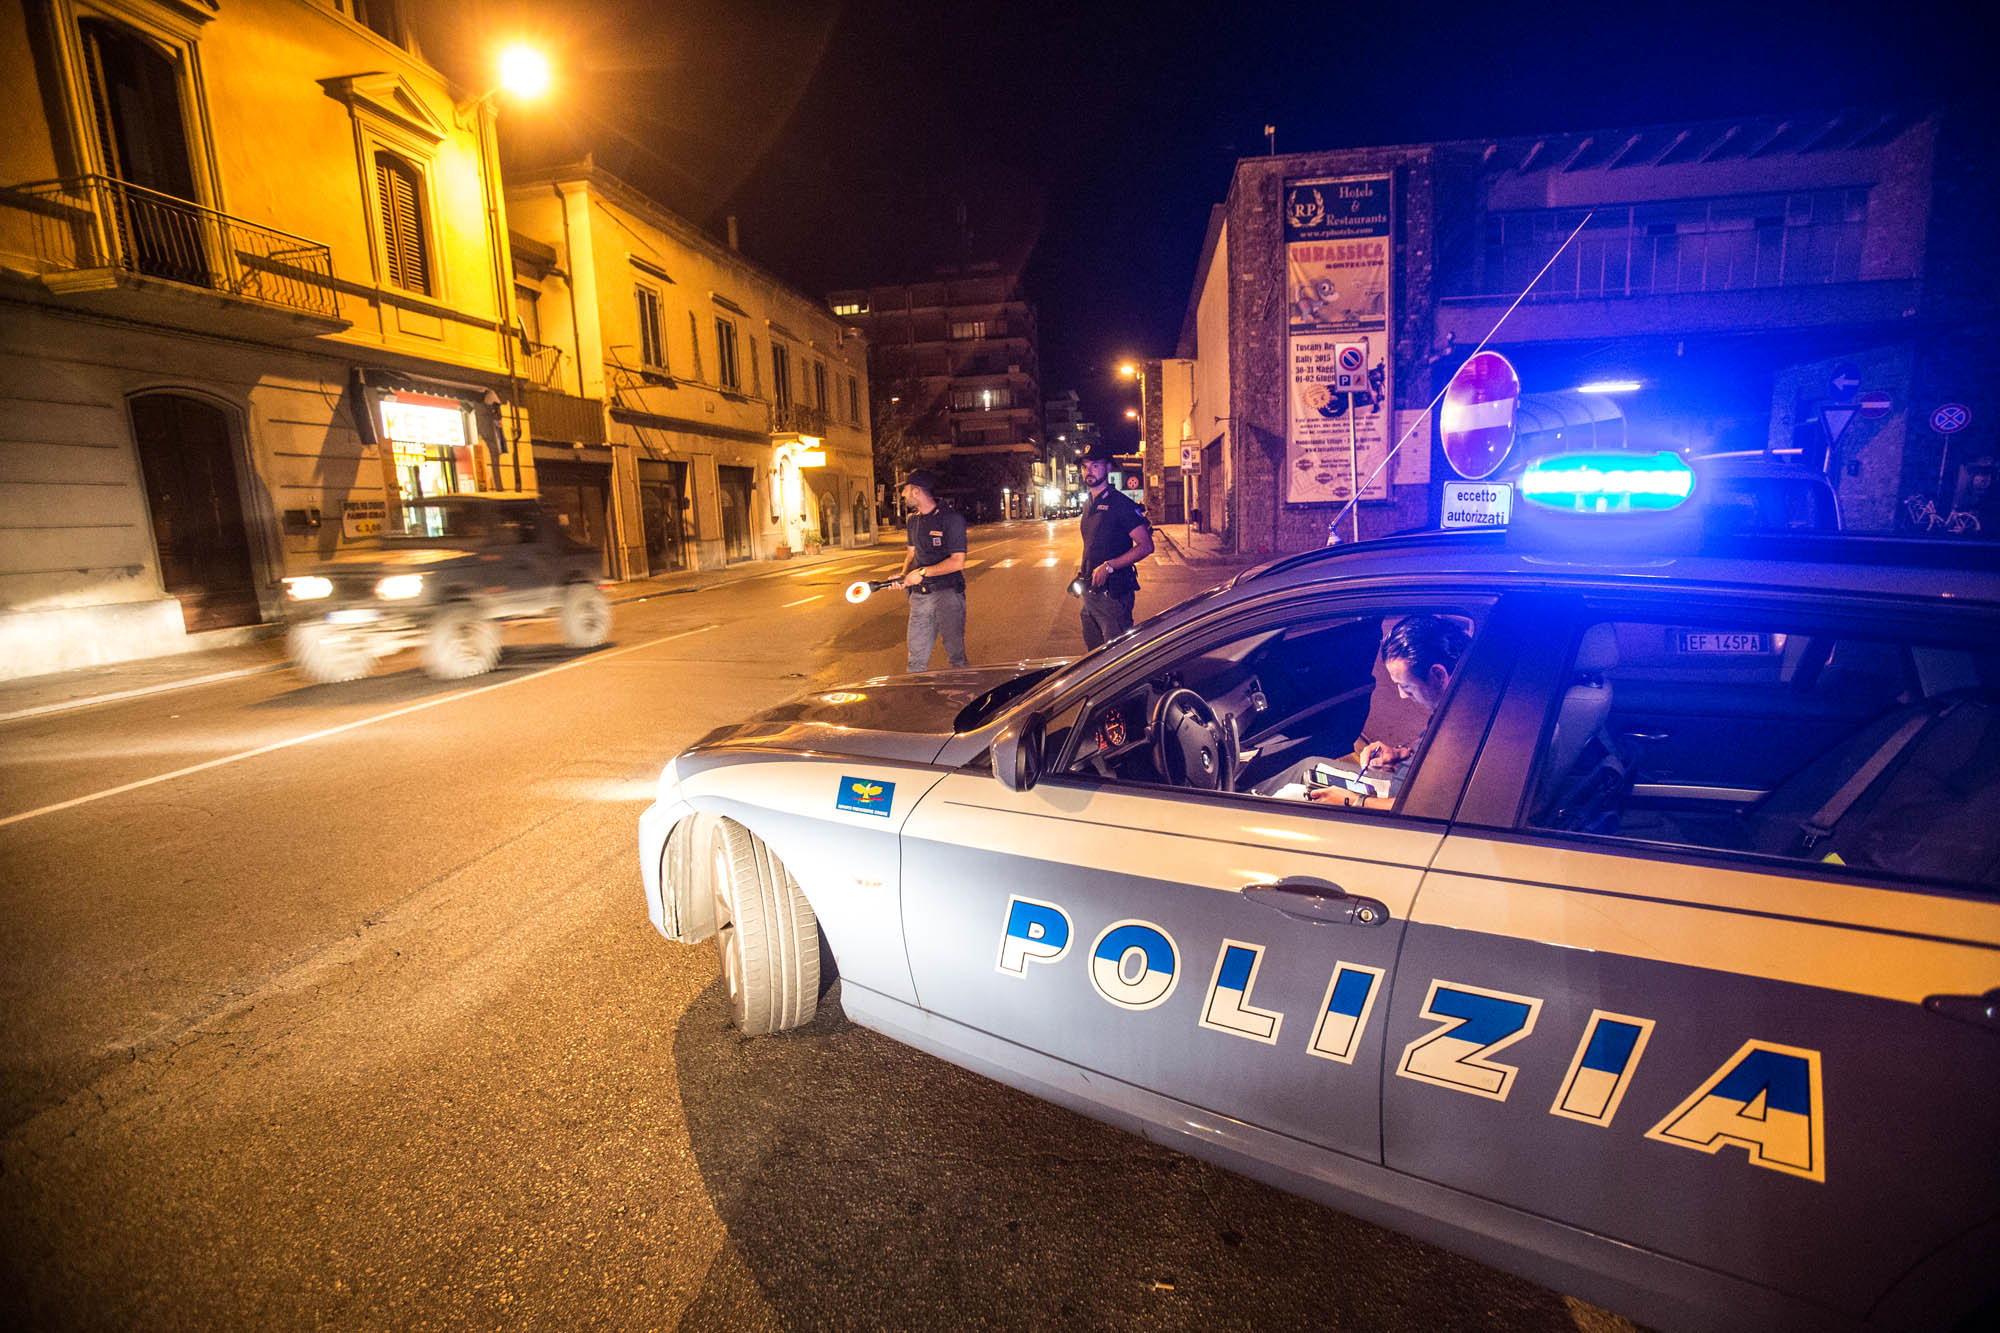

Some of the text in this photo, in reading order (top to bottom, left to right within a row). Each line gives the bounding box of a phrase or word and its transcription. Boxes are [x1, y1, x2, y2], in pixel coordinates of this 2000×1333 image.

[1339, 183, 1373, 199] Hotels
[1295, 203, 1316, 218] RP
[1326, 213, 1387, 227] Restaurants
[1296, 343, 1322, 352] Tuscany
[1315, 354, 1331, 363] 2015
[1316, 365, 1335, 374] Magg
[1296, 374, 1335, 383] 01-02 Giugn
[1341, 376, 1349, 385] P
[1457, 489, 1497, 502] eccetto
[1447, 509, 1505, 525] autorizzati
[1689, 635, 1706, 650] EF
[994, 893, 1826, 1184] POLIZIA
